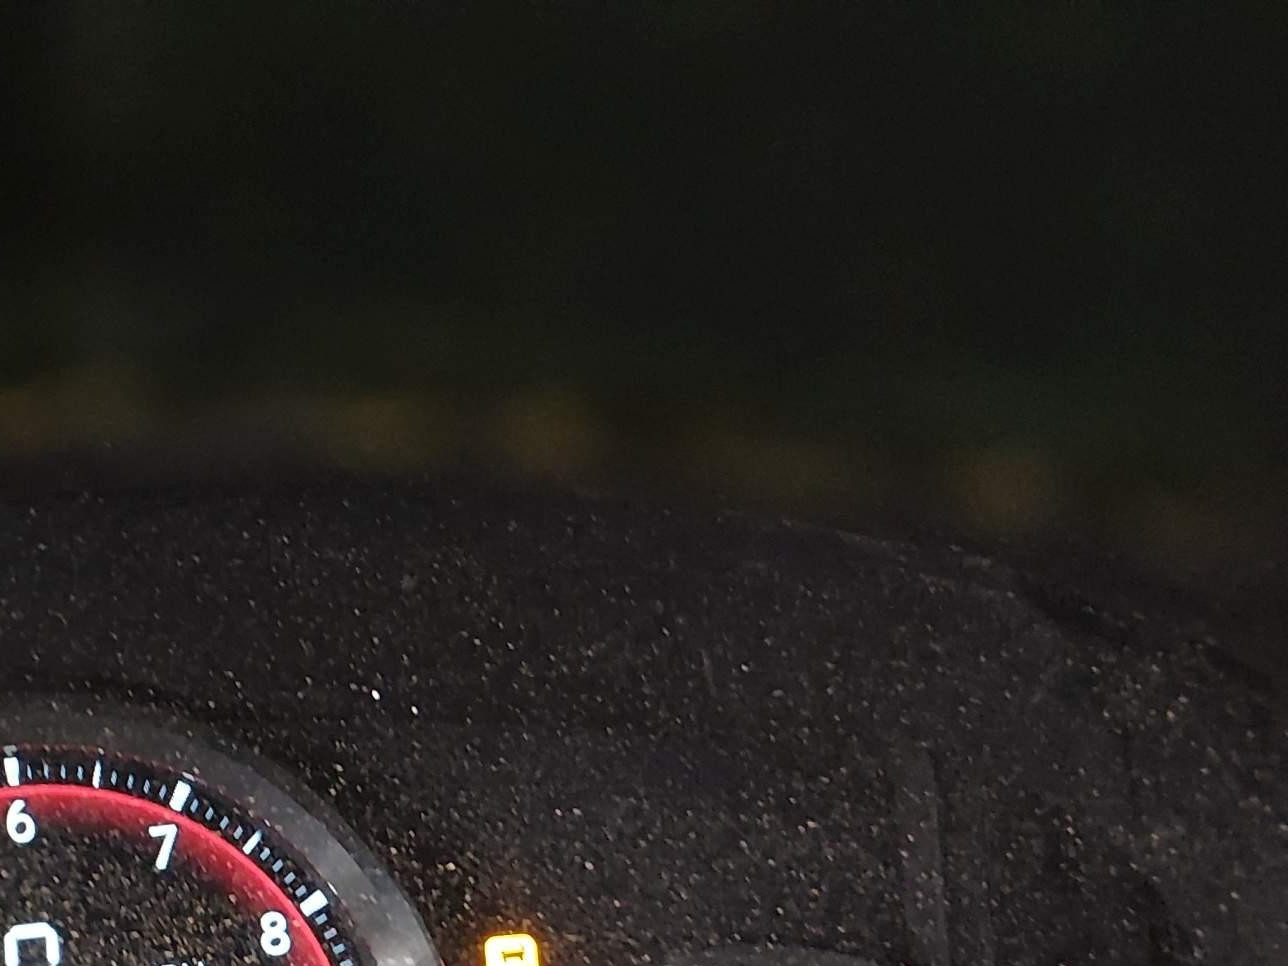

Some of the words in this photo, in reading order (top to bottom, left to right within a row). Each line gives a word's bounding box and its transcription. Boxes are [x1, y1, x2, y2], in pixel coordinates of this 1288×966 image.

[6, 800, 36, 844] 6
[148, 824, 178, 870] 7
[259, 911, 292, 958] 8
